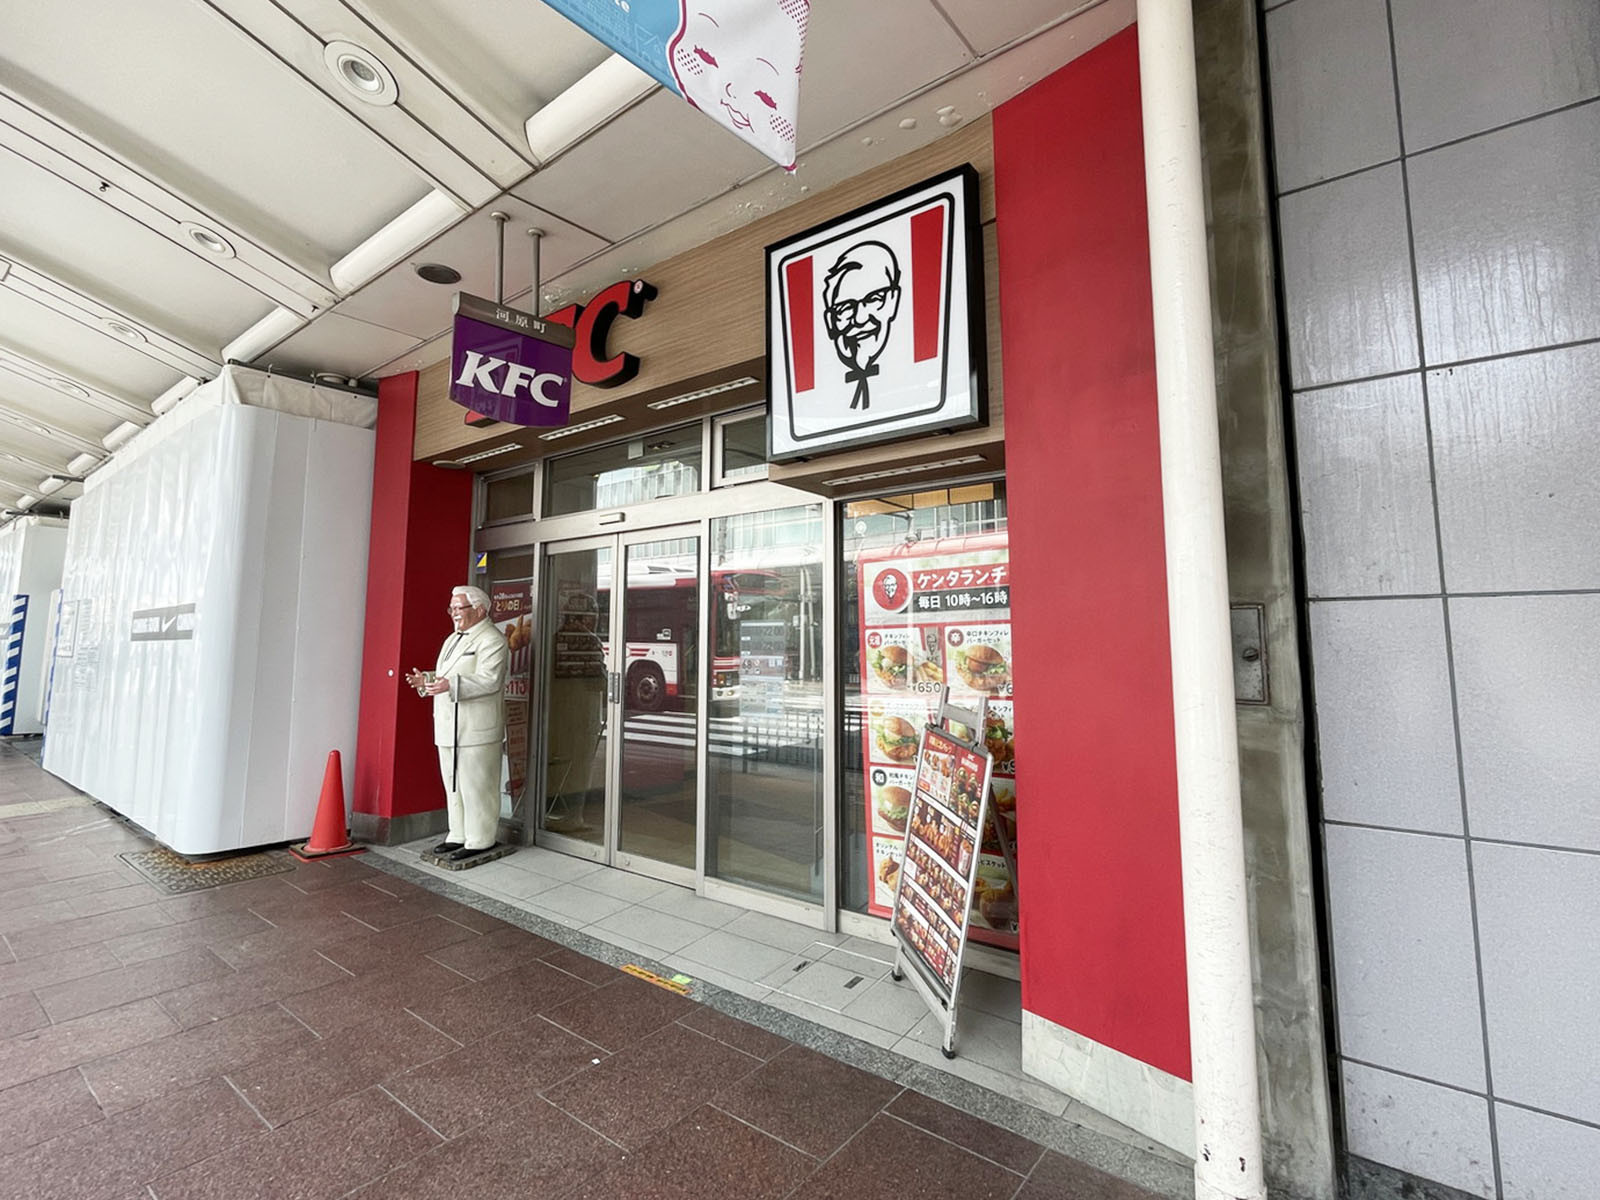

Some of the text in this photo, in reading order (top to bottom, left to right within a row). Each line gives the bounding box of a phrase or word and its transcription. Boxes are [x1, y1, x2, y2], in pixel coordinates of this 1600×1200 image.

[496, 308, 546, 333] 河原町
[455, 350, 565, 408] KFC
[917, 566, 1007, 589] ケンタランチ
[918, 595, 940, 609] 毎日
